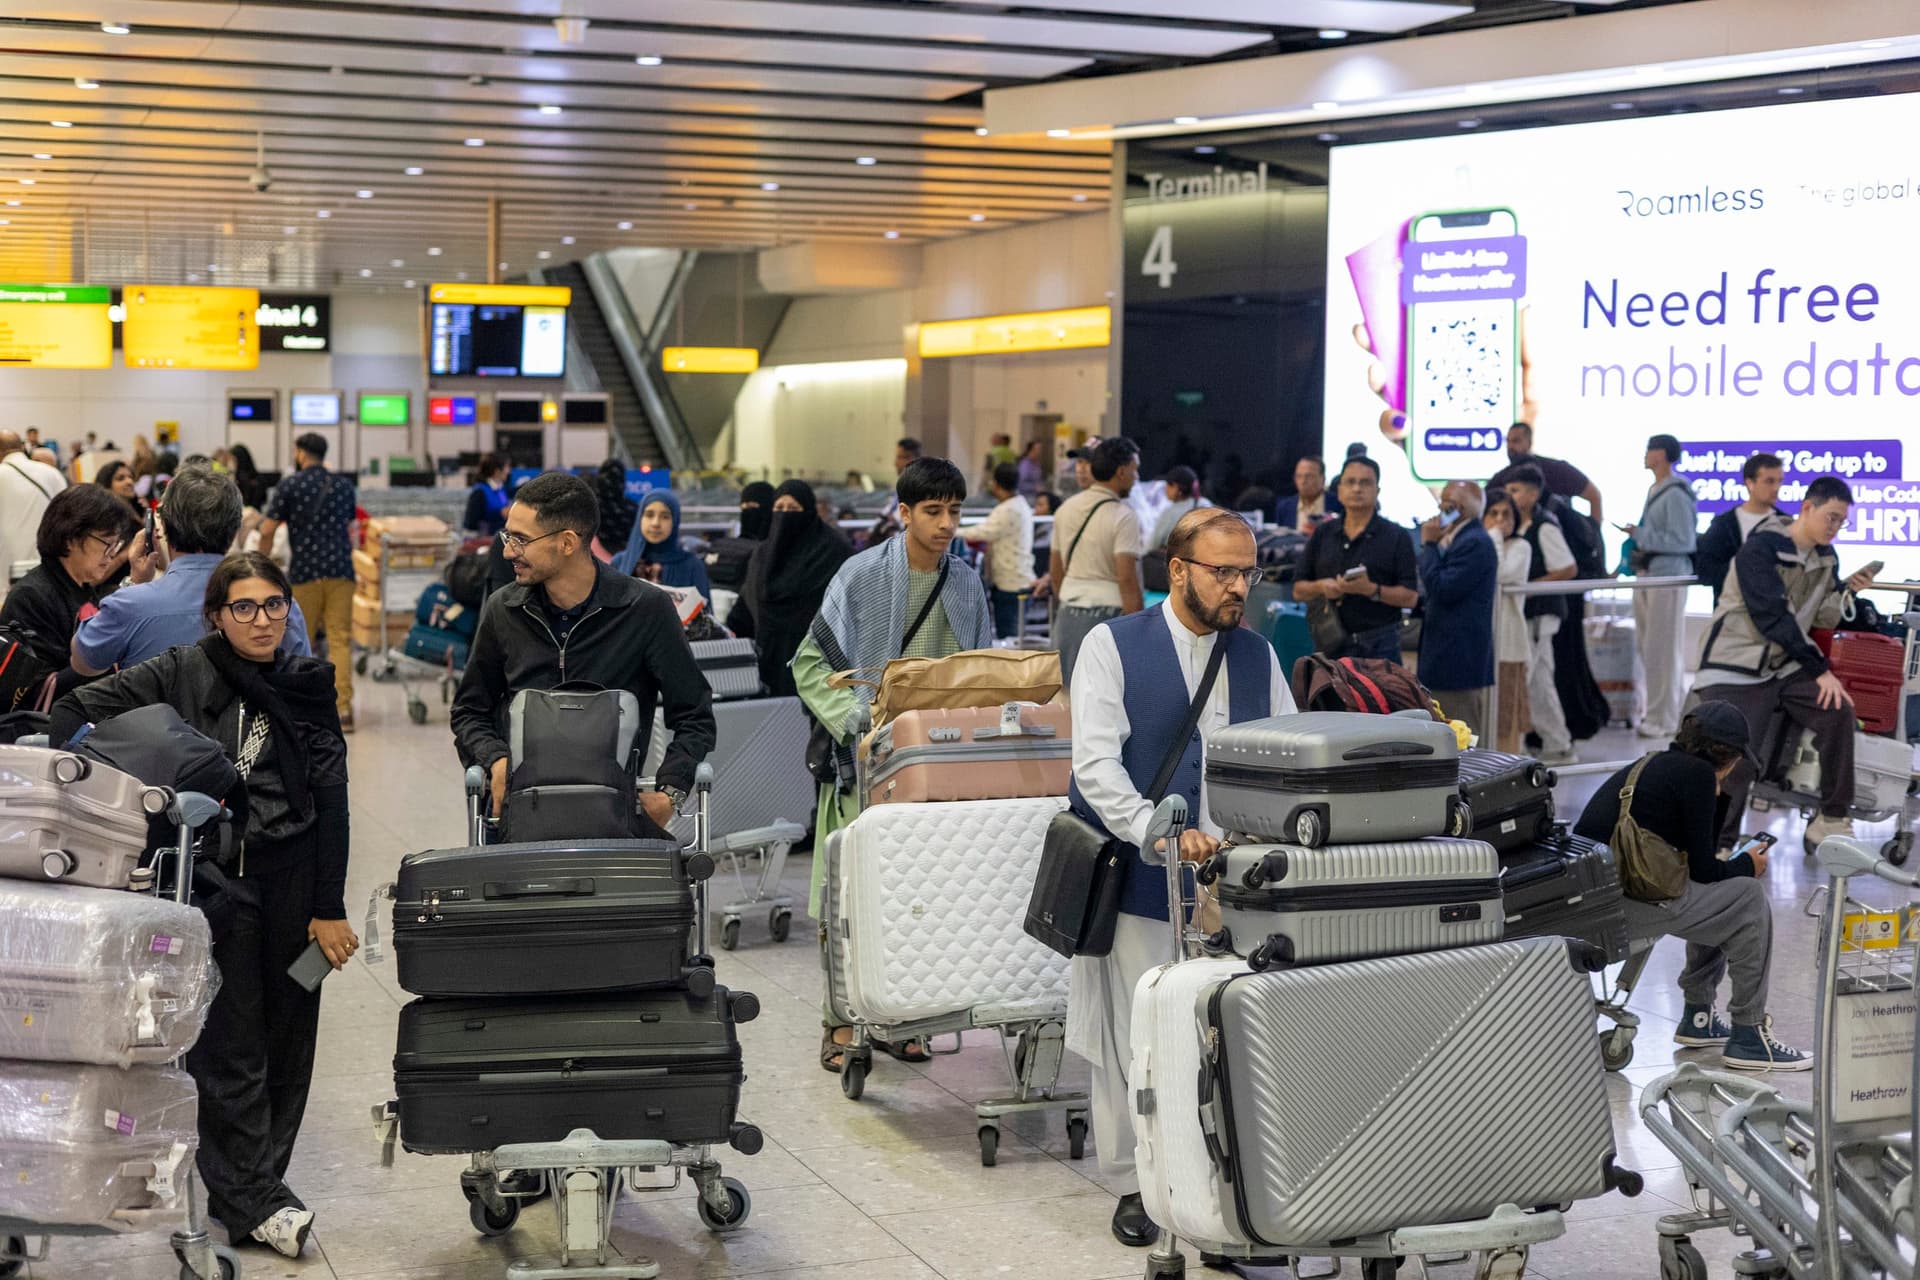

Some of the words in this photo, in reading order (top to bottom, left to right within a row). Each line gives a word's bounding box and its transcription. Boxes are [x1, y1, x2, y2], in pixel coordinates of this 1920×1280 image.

[1144, 162, 1266, 201] Terminal
[1842, 176, 1911, 208] global
[1616, 184, 1764, 217] Roamless
[1142, 225, 1177, 288] 4
[1583, 272, 1727, 329] Need
[1747, 268, 1880, 325] free
[1582, 344, 1763, 397] mobile
[1676, 450, 1716, 472] Just
[1794, 451, 1834, 473] Get
[1835, 456, 1862, 477] up
[1862, 451, 1888, 473] to
[1852, 485, 1882, 504] Use
[1883, 485, 1920, 504] Cod
[1850, 1086, 1908, 1103] Heathrow
